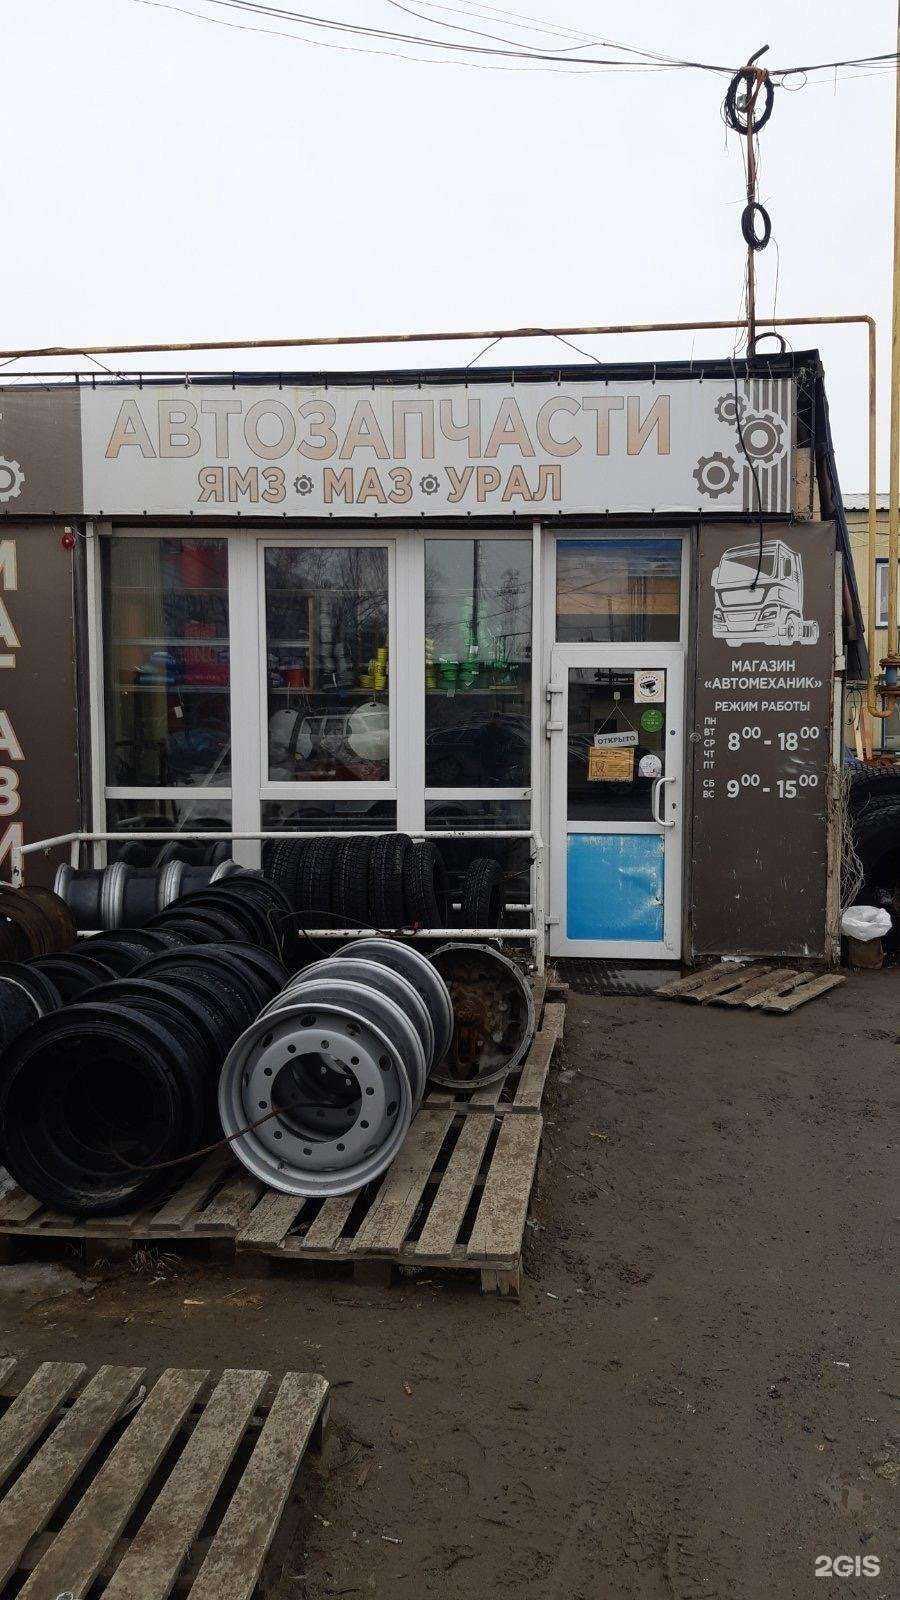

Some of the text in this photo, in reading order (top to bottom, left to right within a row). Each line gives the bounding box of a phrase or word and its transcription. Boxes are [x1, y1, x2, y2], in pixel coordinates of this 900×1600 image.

[105, 395, 671, 460] АВТОЗАПЧАСТИ
[198, 464, 562, 504] ЯМЗ МАЗ УРАЛ
[731, 660, 796, 672] МАГАЗИН
[704, 677, 822, 690] «АВТОМЕХАНИК»
[714, 701, 810, 712] РЕЖИМ РАБОТЫ
[704, 717, 717, 725] ПН
[703, 728, 715, 736] ВТ
[703, 739, 716, 747] СР
[703, 750, 715, 758] ЧТ
[703, 761, 715, 769] ПТ
[702, 779, 715, 787] СБ
[702, 790, 715, 798] ВС
